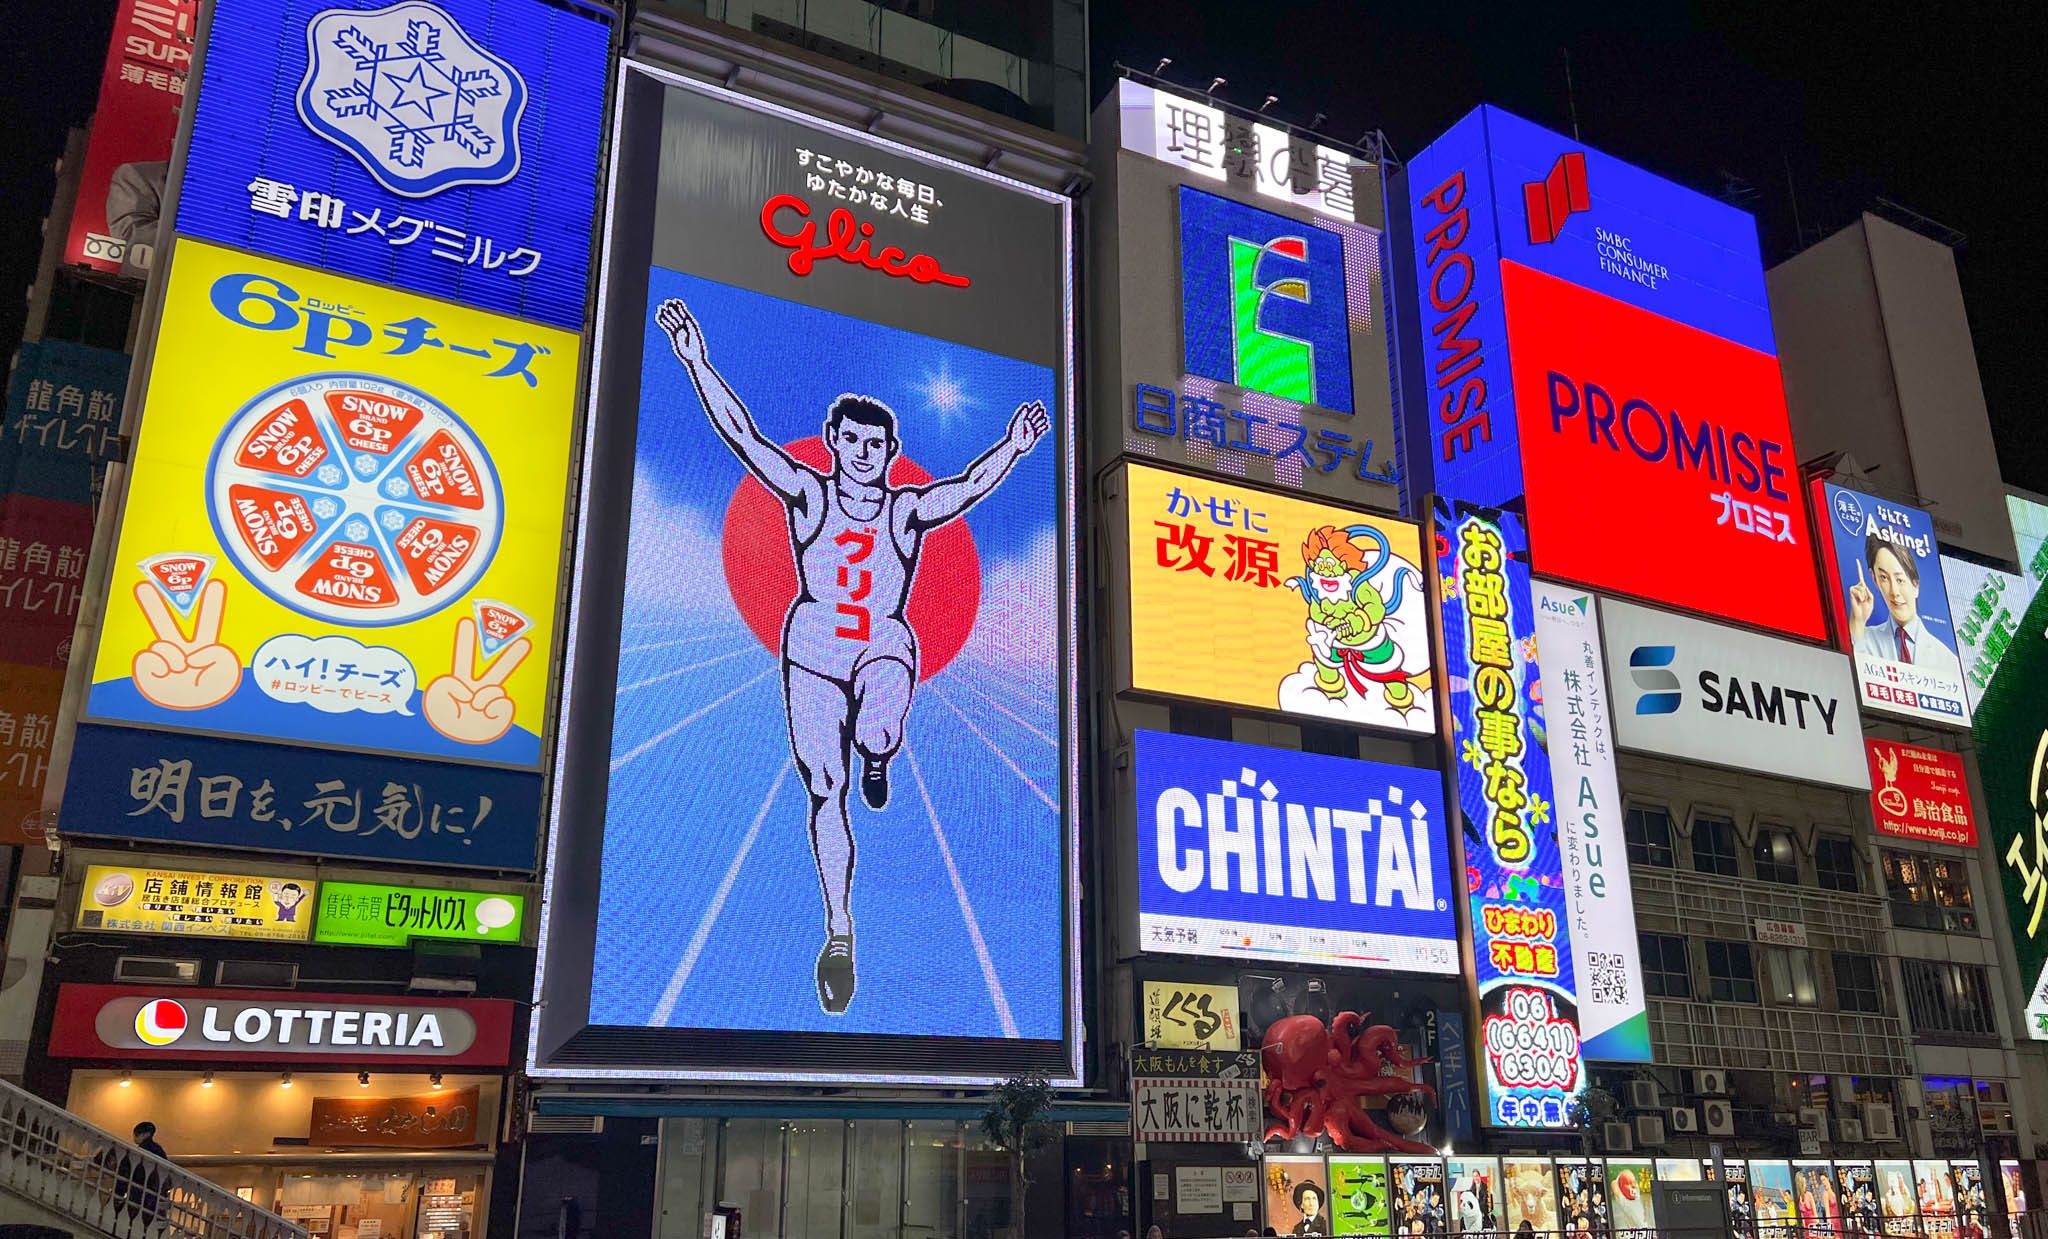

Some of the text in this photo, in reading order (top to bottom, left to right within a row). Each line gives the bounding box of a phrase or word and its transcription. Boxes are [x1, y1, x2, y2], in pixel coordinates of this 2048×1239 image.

[125, 36, 193, 64] SUP
[795, 147, 945, 208] すこやかな毎日、
[806, 172, 929, 224] ゆたかな人生
[246, 177, 542, 277] 雪印メグミルク
[1595, 226, 1632, 252] SMBC
[1597, 241, 1670, 281] CONSUMER
[1600, 256, 1657, 290] FINANCE
[307, 297, 366, 316] ロッピー
[1421, 170, 1492, 463] PROMISE
[26, 378, 117, 422] 龍角散
[341, 395, 409, 421] SNOW
[248, 408, 299, 459] SNOW
[348, 437, 389, 452] CHEESE
[1136, 382, 1403, 484] 日商エステム
[1546, 369, 1789, 502] PROMISE
[295, 446, 325, 475] CHEESE
[439, 444, 478, 497] SNOW
[408, 464, 430, 498] CHEESE
[236, 498, 279, 556] SNOW
[290, 497, 314, 532] CHEESE
[1166, 486, 1269, 533] かぜに
[1709, 491, 1796, 544] プロミス
[333, 544, 374, 559] CHEESE
[397, 519, 426, 549] CHEESE
[1865, 513, 1932, 558] Asking!
[160, 562, 197, 573] SNOW
[423, 534, 470, 587] SNOW
[1154, 520, 1282, 588] 改源
[312, 578, 382, 603] SNOW
[833, 527, 878, 642] グリコ
[487, 608, 519, 626] SNOW
[1540, 595, 1576, 616] Asue
[1461, 520, 1532, 863] お部屋の事なら
[1863, 662, 1959, 694] AGA スキンクリニック
[1582, 640, 1607, 761] 丸善インテックは、
[1698, 670, 1838, 736] SAMTY
[1563, 668, 1606, 898] 株式会社 Asue
[1156, 766, 1435, 912] CHINTAI
[143, 878, 263, 900] 店舗情報館
[146, 871, 264, 884] KANSAI INVEST CORPORATION
[1566, 822, 1590, 939] に変わりました。
[325, 893, 466, 931] 賃貸・売買 ピタットハウス
[1484, 906, 1556, 940] ひまわり
[1151, 925, 1199, 944] 天気予報
[1491, 942, 1557, 975] 不動産
[1162, 991, 1221, 1040] くくる
[1510, 991, 1548, 1021] 06
[202, 1006, 445, 1048] LOTTERIA
[1486, 1021, 1578, 1057] (6641)
[1135, 1055, 1224, 1074] 大阪もんを食す
[1501, 1053, 1571, 1083] 6304
[1141, 1088, 1244, 1132] 大阪に乾杯
